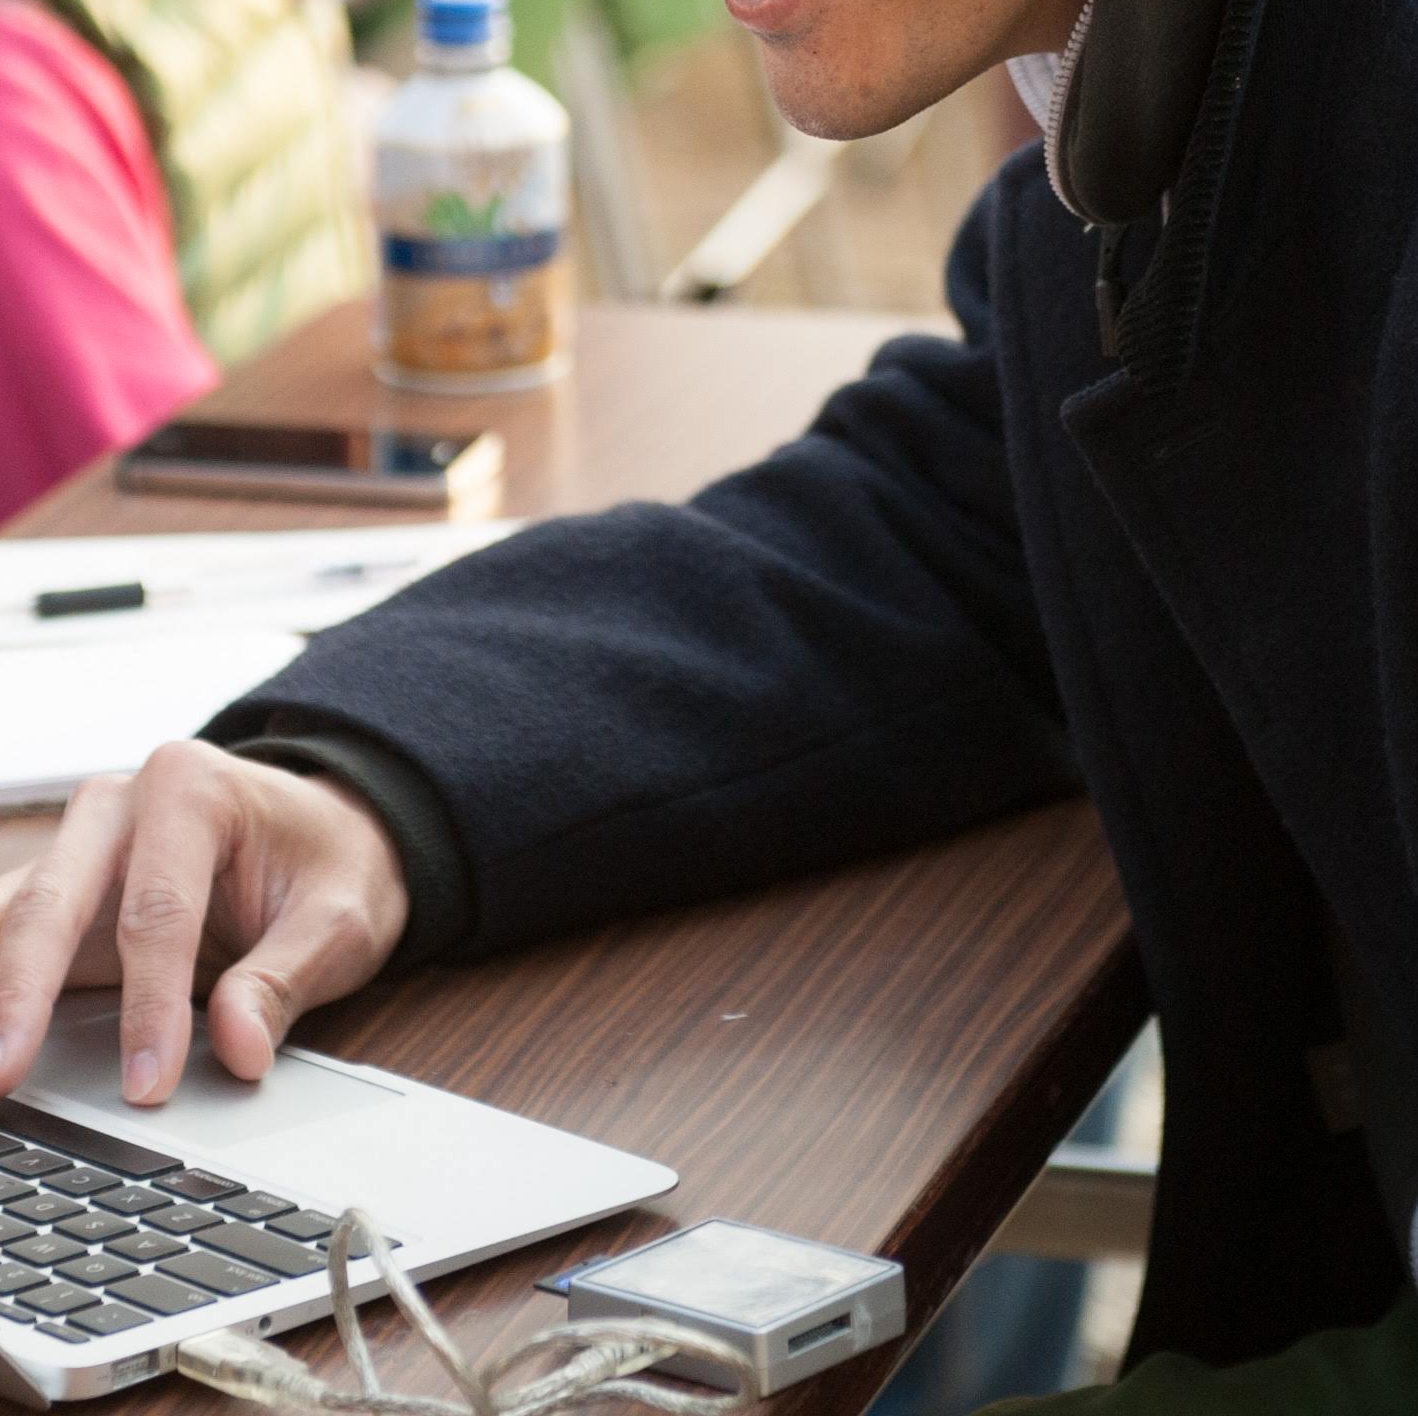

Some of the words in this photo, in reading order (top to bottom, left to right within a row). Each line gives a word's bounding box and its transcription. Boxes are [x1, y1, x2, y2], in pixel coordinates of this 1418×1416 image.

[21, 1157, 41, 1167] V
[71, 1175, 91, 1185] C
[121, 1193, 142, 1204] X
[34, 1202, 56, 1212] D
[170, 1212, 193, 1223] Z
[84, 1220, 105, 1230] S
[31, 1243, 56, 1254] W
[136, 1239, 158, 1250] A
[85, 1262, 105, 1273] Q
